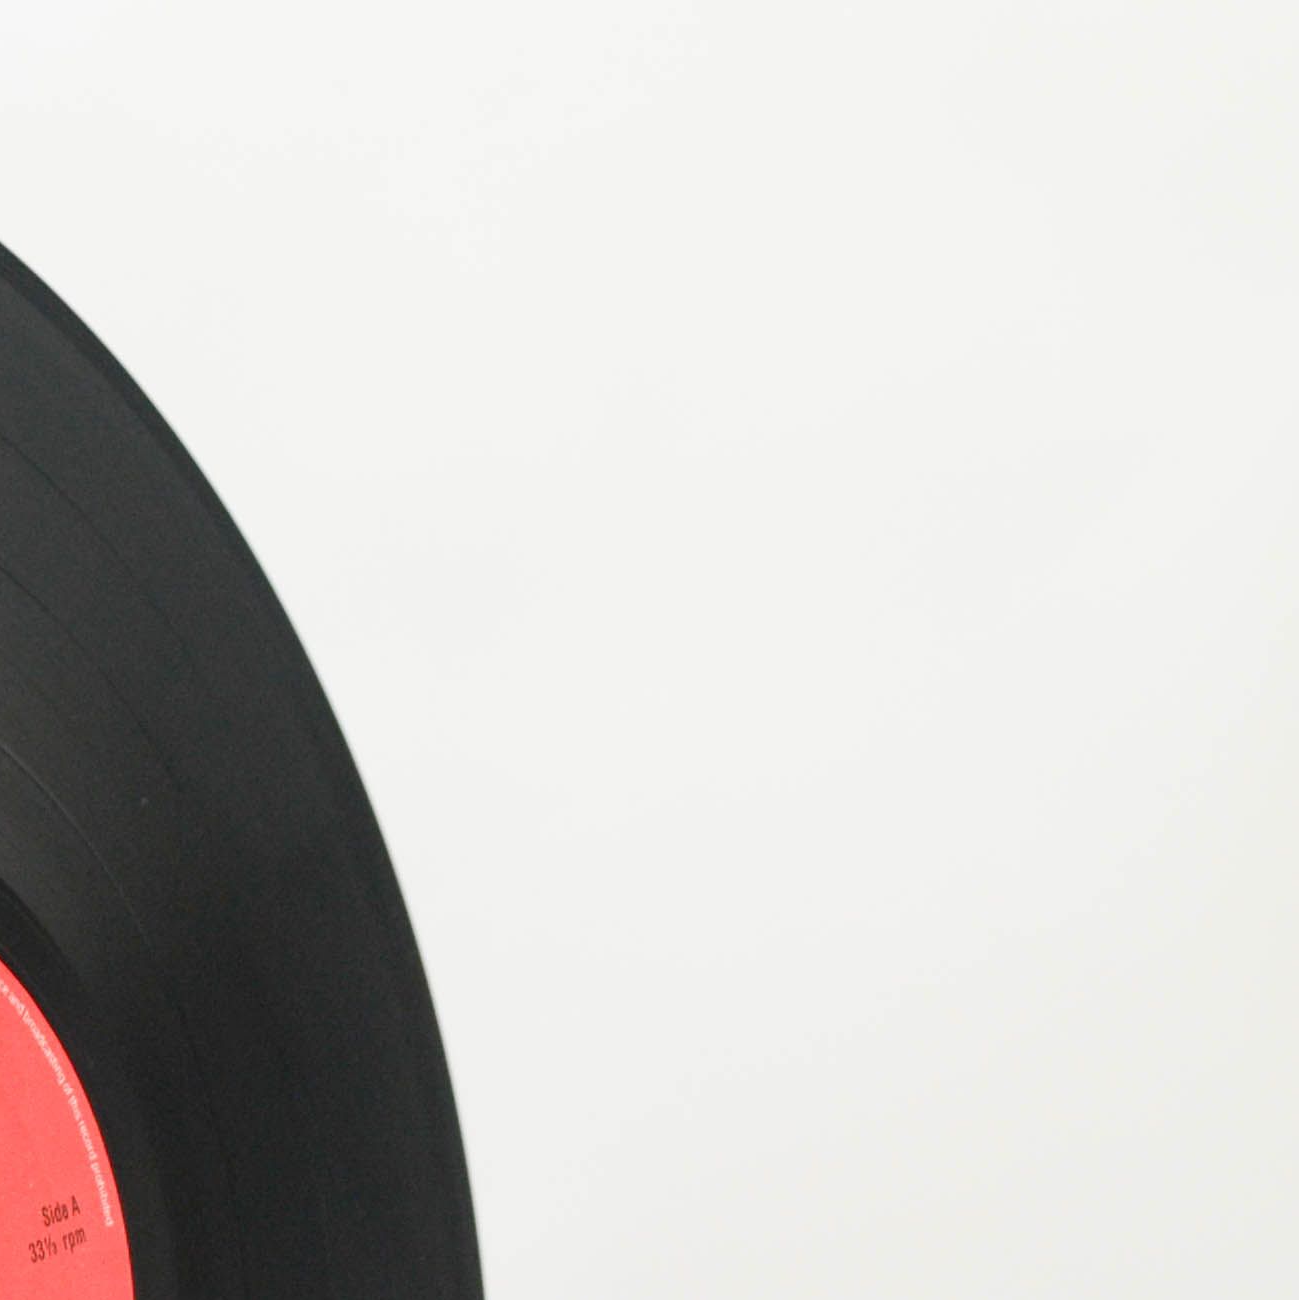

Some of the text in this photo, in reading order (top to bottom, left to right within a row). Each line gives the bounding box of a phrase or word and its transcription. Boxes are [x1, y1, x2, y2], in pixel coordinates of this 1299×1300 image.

[42, 1195, 81, 1227] Side A
[62, 1228, 87, 1254] rpm
